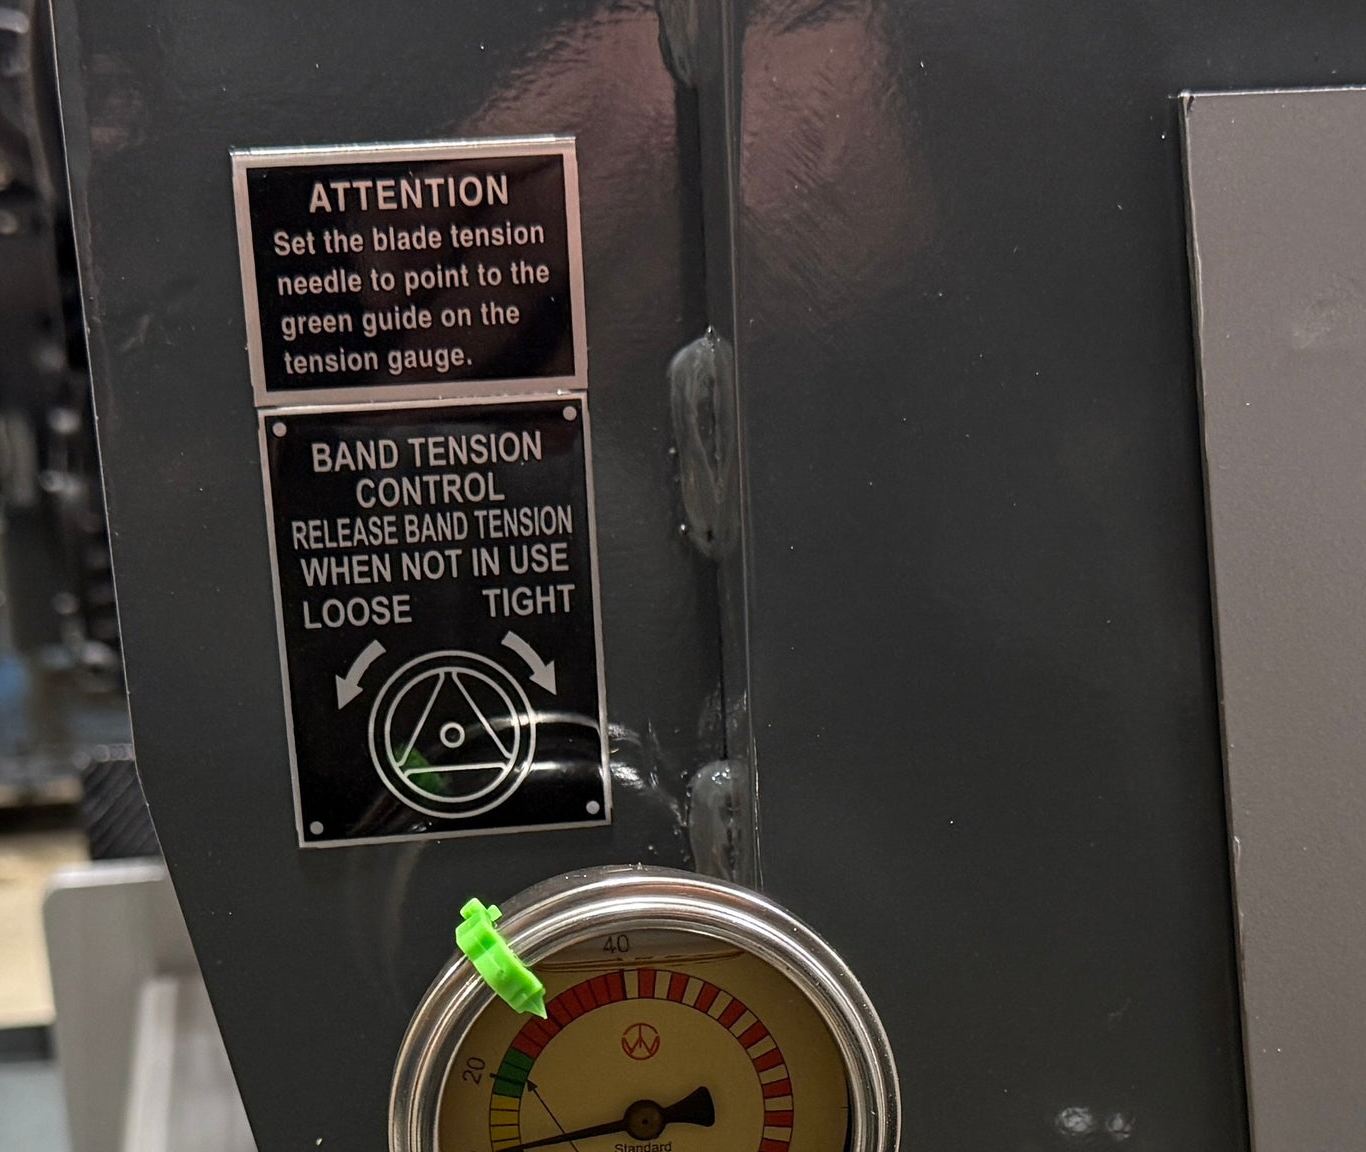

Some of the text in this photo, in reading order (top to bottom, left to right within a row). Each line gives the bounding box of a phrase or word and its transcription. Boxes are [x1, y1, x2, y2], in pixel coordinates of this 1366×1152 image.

[309, 175, 509, 213] ATTENTION
[273, 222, 545, 256] Set the blade tension
[278, 261, 550, 296] needle to point to the
[281, 302, 520, 341] green guide on the
[284, 347, 472, 377] tension gauge.
[311, 431, 542, 473] BAND TENSION
[356, 472, 505, 508] CONTROL
[292, 505, 573, 550] RELEASE BAND TENSION
[300, 542, 569, 587] WHEN NOT IN USE
[303, 595, 412, 629] LOOSE
[482, 583, 575, 617] TIGHT
[602, 934, 630, 954] 40
[462, 1057, 485, 1085] 20
